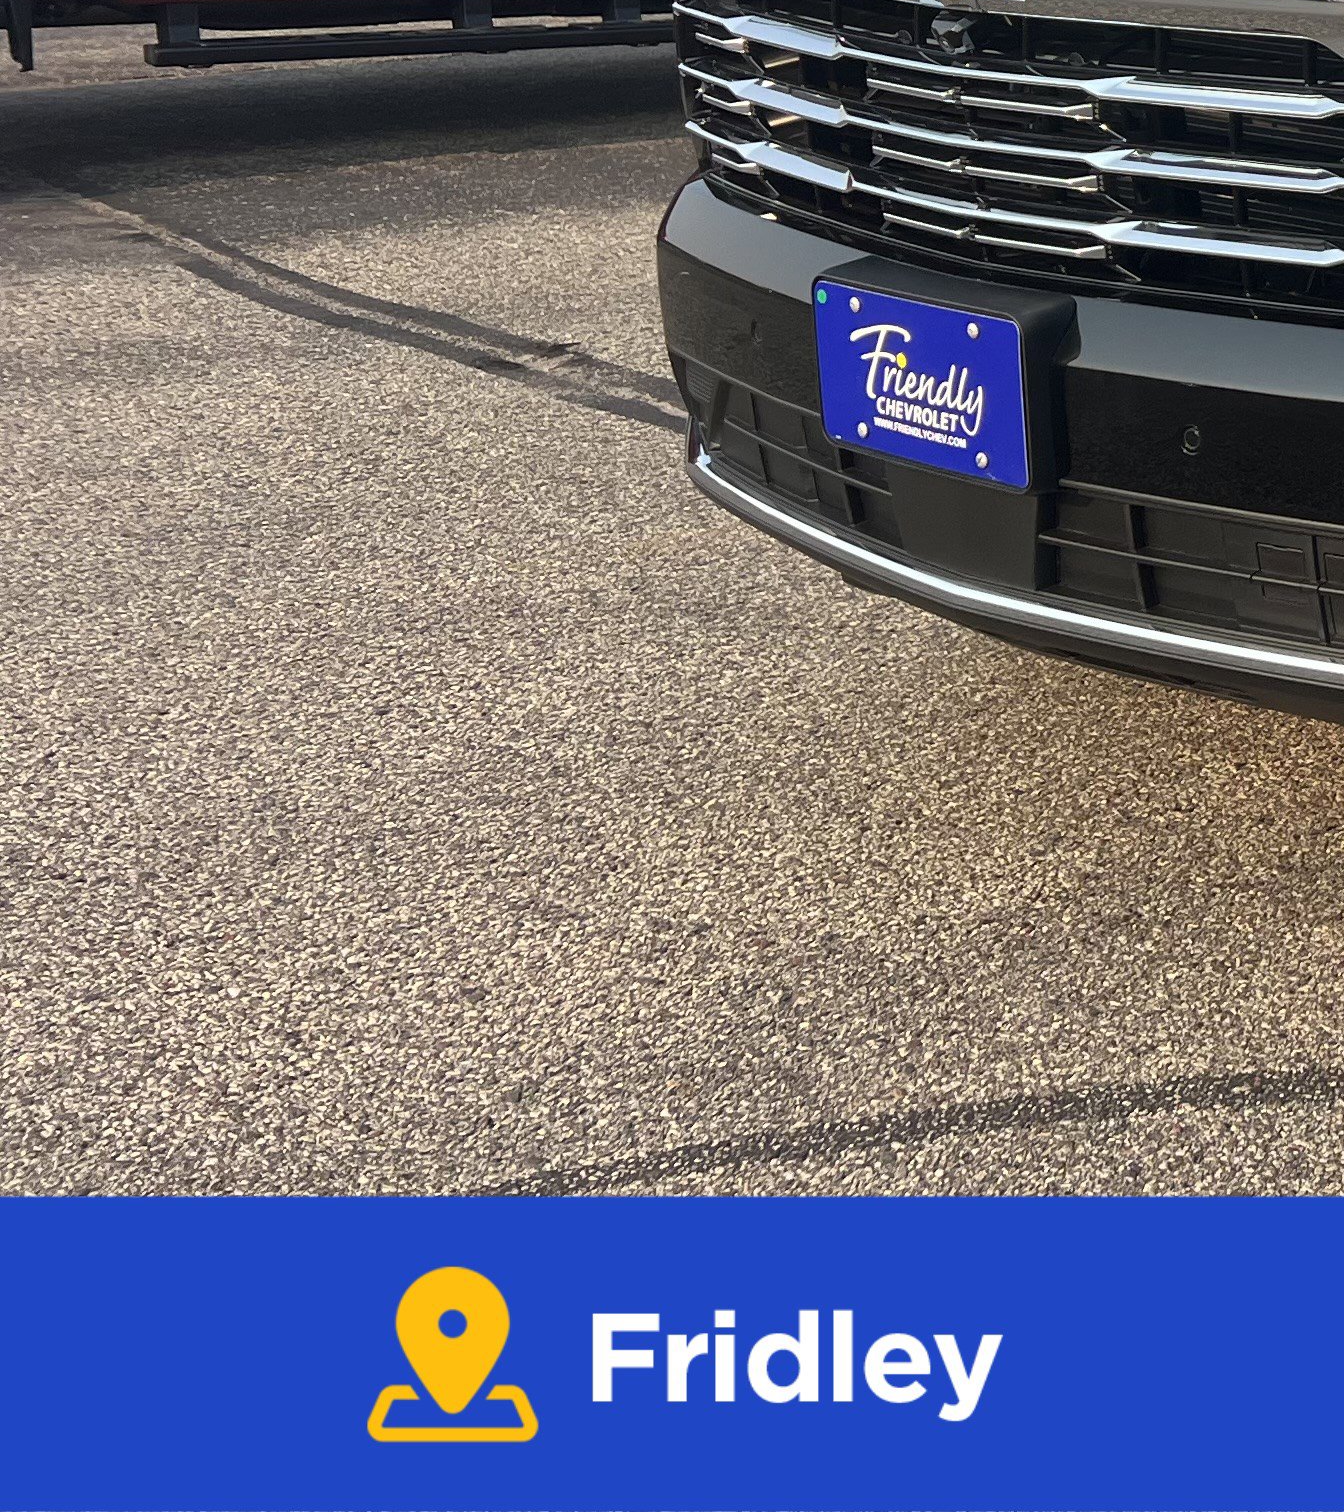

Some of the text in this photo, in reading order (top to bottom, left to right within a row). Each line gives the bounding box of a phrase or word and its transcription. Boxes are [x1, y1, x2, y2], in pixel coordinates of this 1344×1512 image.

[849, 324, 984, 437] Friendly
[876, 396, 959, 432] CHEVROLET
[873, 416, 967, 449] WWW.FRIENDLYCHEV.COM
